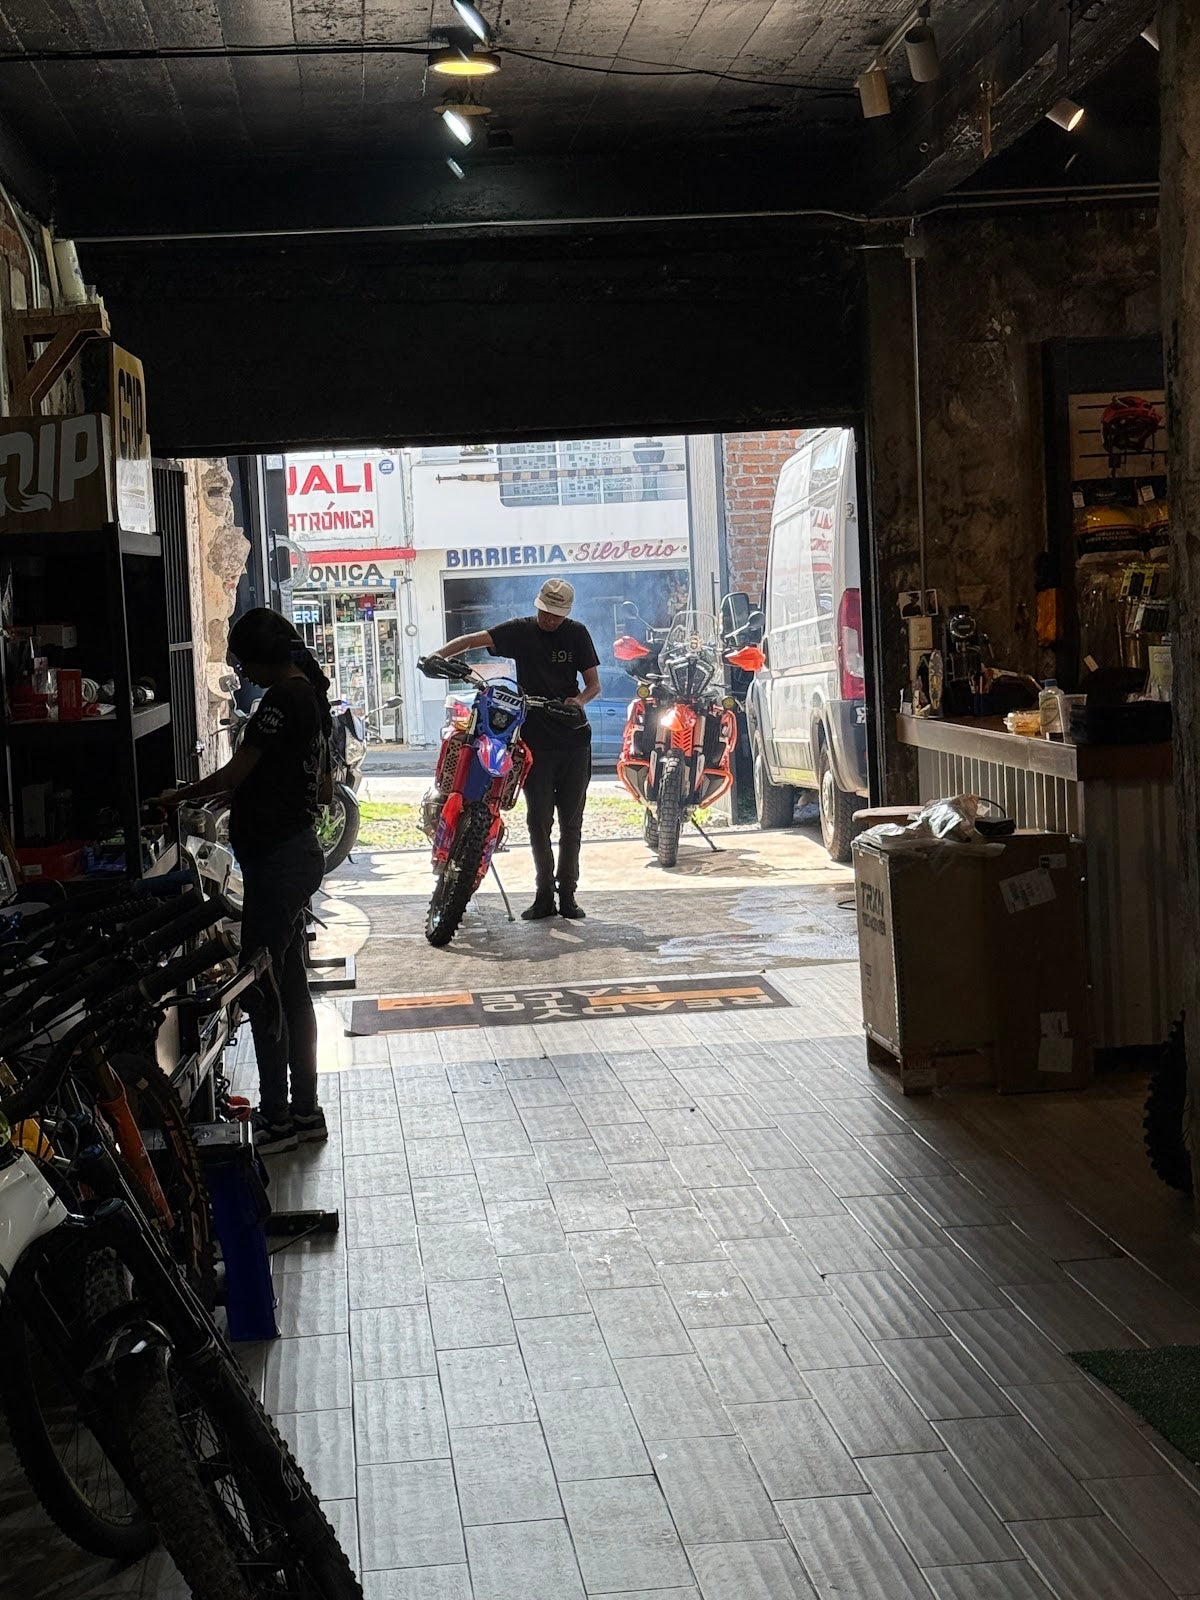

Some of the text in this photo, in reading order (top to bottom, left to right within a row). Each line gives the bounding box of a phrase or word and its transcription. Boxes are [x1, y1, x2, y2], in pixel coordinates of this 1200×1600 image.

[446, 538, 681, 568] BIRRIERIA Silverio
[480, 984, 661, 1004] RACE
[482, 1000, 573, 1013] TO
[533, 994, 775, 1020] READY
